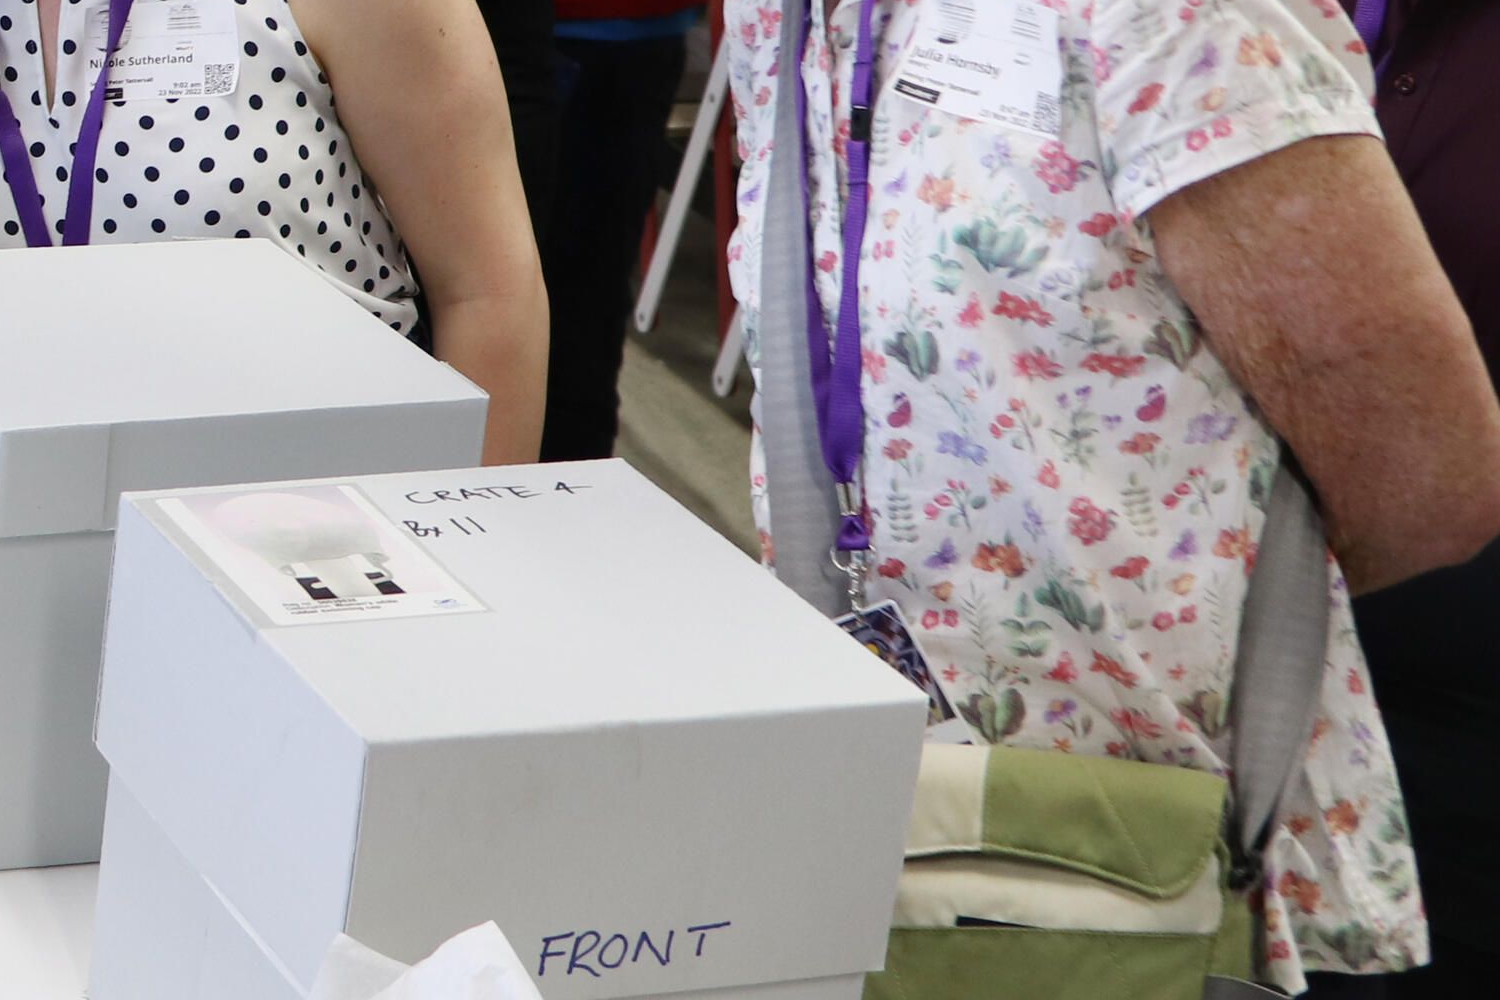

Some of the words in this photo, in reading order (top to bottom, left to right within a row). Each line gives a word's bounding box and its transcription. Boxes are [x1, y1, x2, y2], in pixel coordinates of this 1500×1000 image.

[90, 58, 125, 69] Niole
[128, 53, 193, 67] Sutherland
[405, 485, 543, 504] CRATE
[554, 481, 593, 494] 4
[537, 920, 732, 978] FRONT
